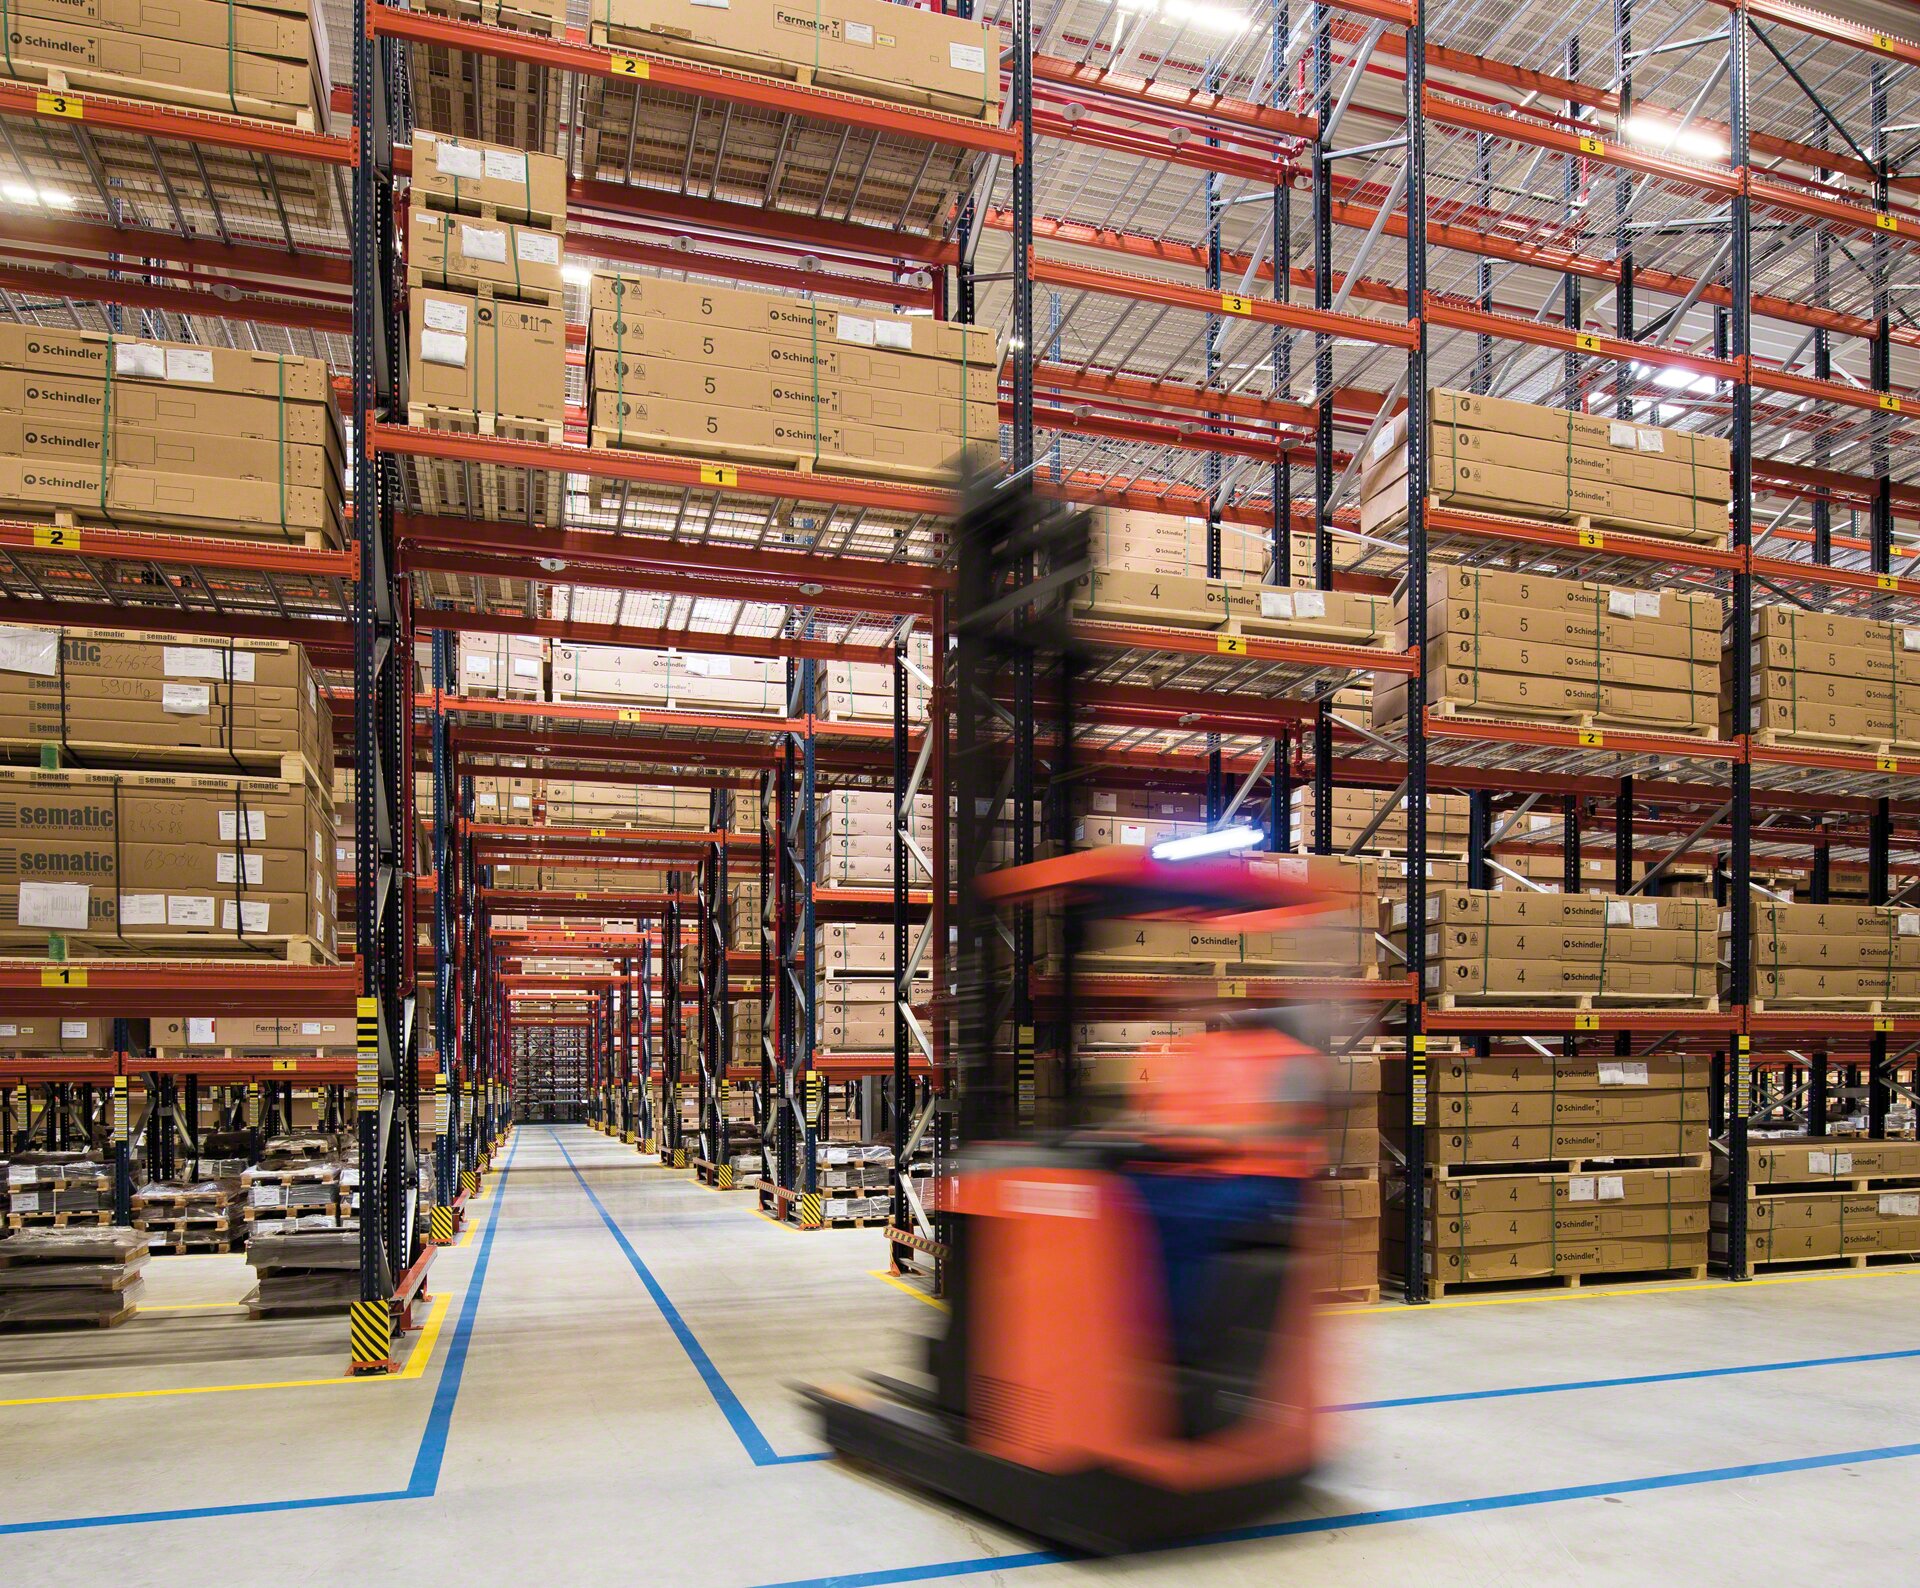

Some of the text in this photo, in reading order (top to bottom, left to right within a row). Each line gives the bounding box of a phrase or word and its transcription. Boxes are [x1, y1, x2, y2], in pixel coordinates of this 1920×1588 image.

[25, 35, 86, 54] Schindler
[1879, 36, 1887, 48] 6
[625, 60, 636, 74] 2
[53, 98, 67, 113] 3
[1588, 140, 1597, 152] 5
[1883, 216, 1891, 228] 5
[702, 297, 713, 315] 5
[1232, 298, 1242, 311] 3
[781, 312, 827, 327] Schinder
[703, 337, 714, 354] 5
[1584, 336, 1593, 348] 4
[42, 345, 103, 360] Schindler
[782, 351, 828, 366] Schindler
[704, 377, 716, 394] 5
[41, 391, 102, 405] Schindler
[784, 390, 830, 405] Schindler
[1886, 398, 1894, 408] 4
[706, 416, 718, 434] 5
[1574, 424, 1605, 436] Schindler
[40, 434, 100, 449] Schindler
[786, 429, 832, 443] Schindler
[1574, 457, 1605, 469] Schindler
[714, 469, 723, 482] 1
[39, 477, 99, 491] Schindler
[1574, 490, 1605, 502] Schindler
[1125, 523, 1131, 533] 5
[1162, 529, 1183, 537] Schindler
[50, 530, 64, 545] 2
[1587, 534, 1596, 545] 3
[1124, 543, 1131, 552] 5
[1161, 547, 1183, 556] Schindler
[1160, 567, 1182, 576] Schindler
[1884, 576, 1893, 588] 3
[1150, 584, 1160, 600] 4
[1520, 584, 1529, 599] 5
[1575, 594, 1606, 605] Schinder
[1520, 617, 1529, 632] 5
[1827, 623, 1835, 637] 5
[94, 629, 279, 647] sematic sematic sematic sematic
[1573, 627, 1605, 637] Schinder
[1872, 632, 1898, 641] Schinder
[1228, 639, 1237, 651] 2
[614, 656, 621, 666] 4
[1520, 649, 1529, 664] 5
[1828, 653, 1836, 667] 5
[1574, 658, 1606, 669] Schinder
[1873, 661, 1899, 670] Schinder
[36, 679, 70, 690] semaic
[881, 680, 888, 690] 4
[1519, 682, 1528, 696] 5
[1827, 683, 1835, 697] 5
[1336, 695, 1343, 704] 4
[1872, 691, 1899, 700] Schindlr
[37, 701, 71, 712] semac
[626, 711, 633, 720] 1
[1828, 713, 1836, 727] 5
[37, 723, 71, 734] semac
[1873, 720, 1900, 729] Schindlr
[1587, 733, 1595, 744] 2
[1884, 759, 1891, 769] 2
[37, 772, 70, 781] sematic
[92, 774, 124, 783] semaic
[145, 776, 176, 785] sematic
[197, 779, 228, 788] sematic
[249, 782, 279, 791] sematic
[886, 799, 892, 809] 4
[1346, 794, 1352, 803] 4
[20, 805, 113, 827] sematic
[1346, 813, 1352, 822] 4
[886, 821, 892, 831] 4
[1345, 832, 1351, 841] 4
[885, 842, 892, 852] 4
[20, 851, 113, 872] sematic
[1517, 903, 1526, 916] 4
[1571, 906, 1603, 916] Schindler
[1817, 913, 1825, 927] 4
[878, 931, 885, 941] 4
[1135, 930, 1146, 946] 4
[1200, 937, 1238, 947] Schindler
[1516, 936, 1525, 950] 4
[1571, 940, 1603, 949] Schindler
[879, 952, 886, 962] 4
[1820, 944, 1827, 958] 4
[59, 969, 71, 985] 1
[1516, 969, 1526, 983] 4
[1571, 972, 1602, 982] Schindler
[1817, 975, 1825, 989] 4
[880, 986, 886, 996] 4
[1229, 983, 1236, 995] 1
[879, 1007, 886, 1016] 4
[255, 1024, 292, 1033] Fermtor
[1584, 1017, 1591, 1028] 1
[1881, 1019, 1887, 1029] 1
[878, 1028, 885, 1038] 4
[1120, 1028, 1127, 1037] 4
[281, 1060, 289, 1069] 1
[1139, 1068, 1149, 1083] 4
[1511, 1067, 1520, 1081] 4
[1564, 1070, 1596, 1078] Schindler
[1511, 1101, 1520, 1116] 4
[1564, 1104, 1595, 1112] Schindler
[1511, 1135, 1520, 1150] 4
[1564, 1137, 1596, 1145] Schindler
[1509, 1187, 1518, 1202] 4
[1805, 1206, 1812, 1219] 4
[1850, 1205, 1875, 1213] Schindler
[1509, 1220, 1518, 1235] 4
[1562, 1220, 1594, 1229] Schindler
[1805, 1235, 1812, 1249] 4
[1850, 1235, 1877, 1243] Schindler
[1509, 1253, 1518, 1267] 4
[1563, 1253, 1595, 1261] Schindler
